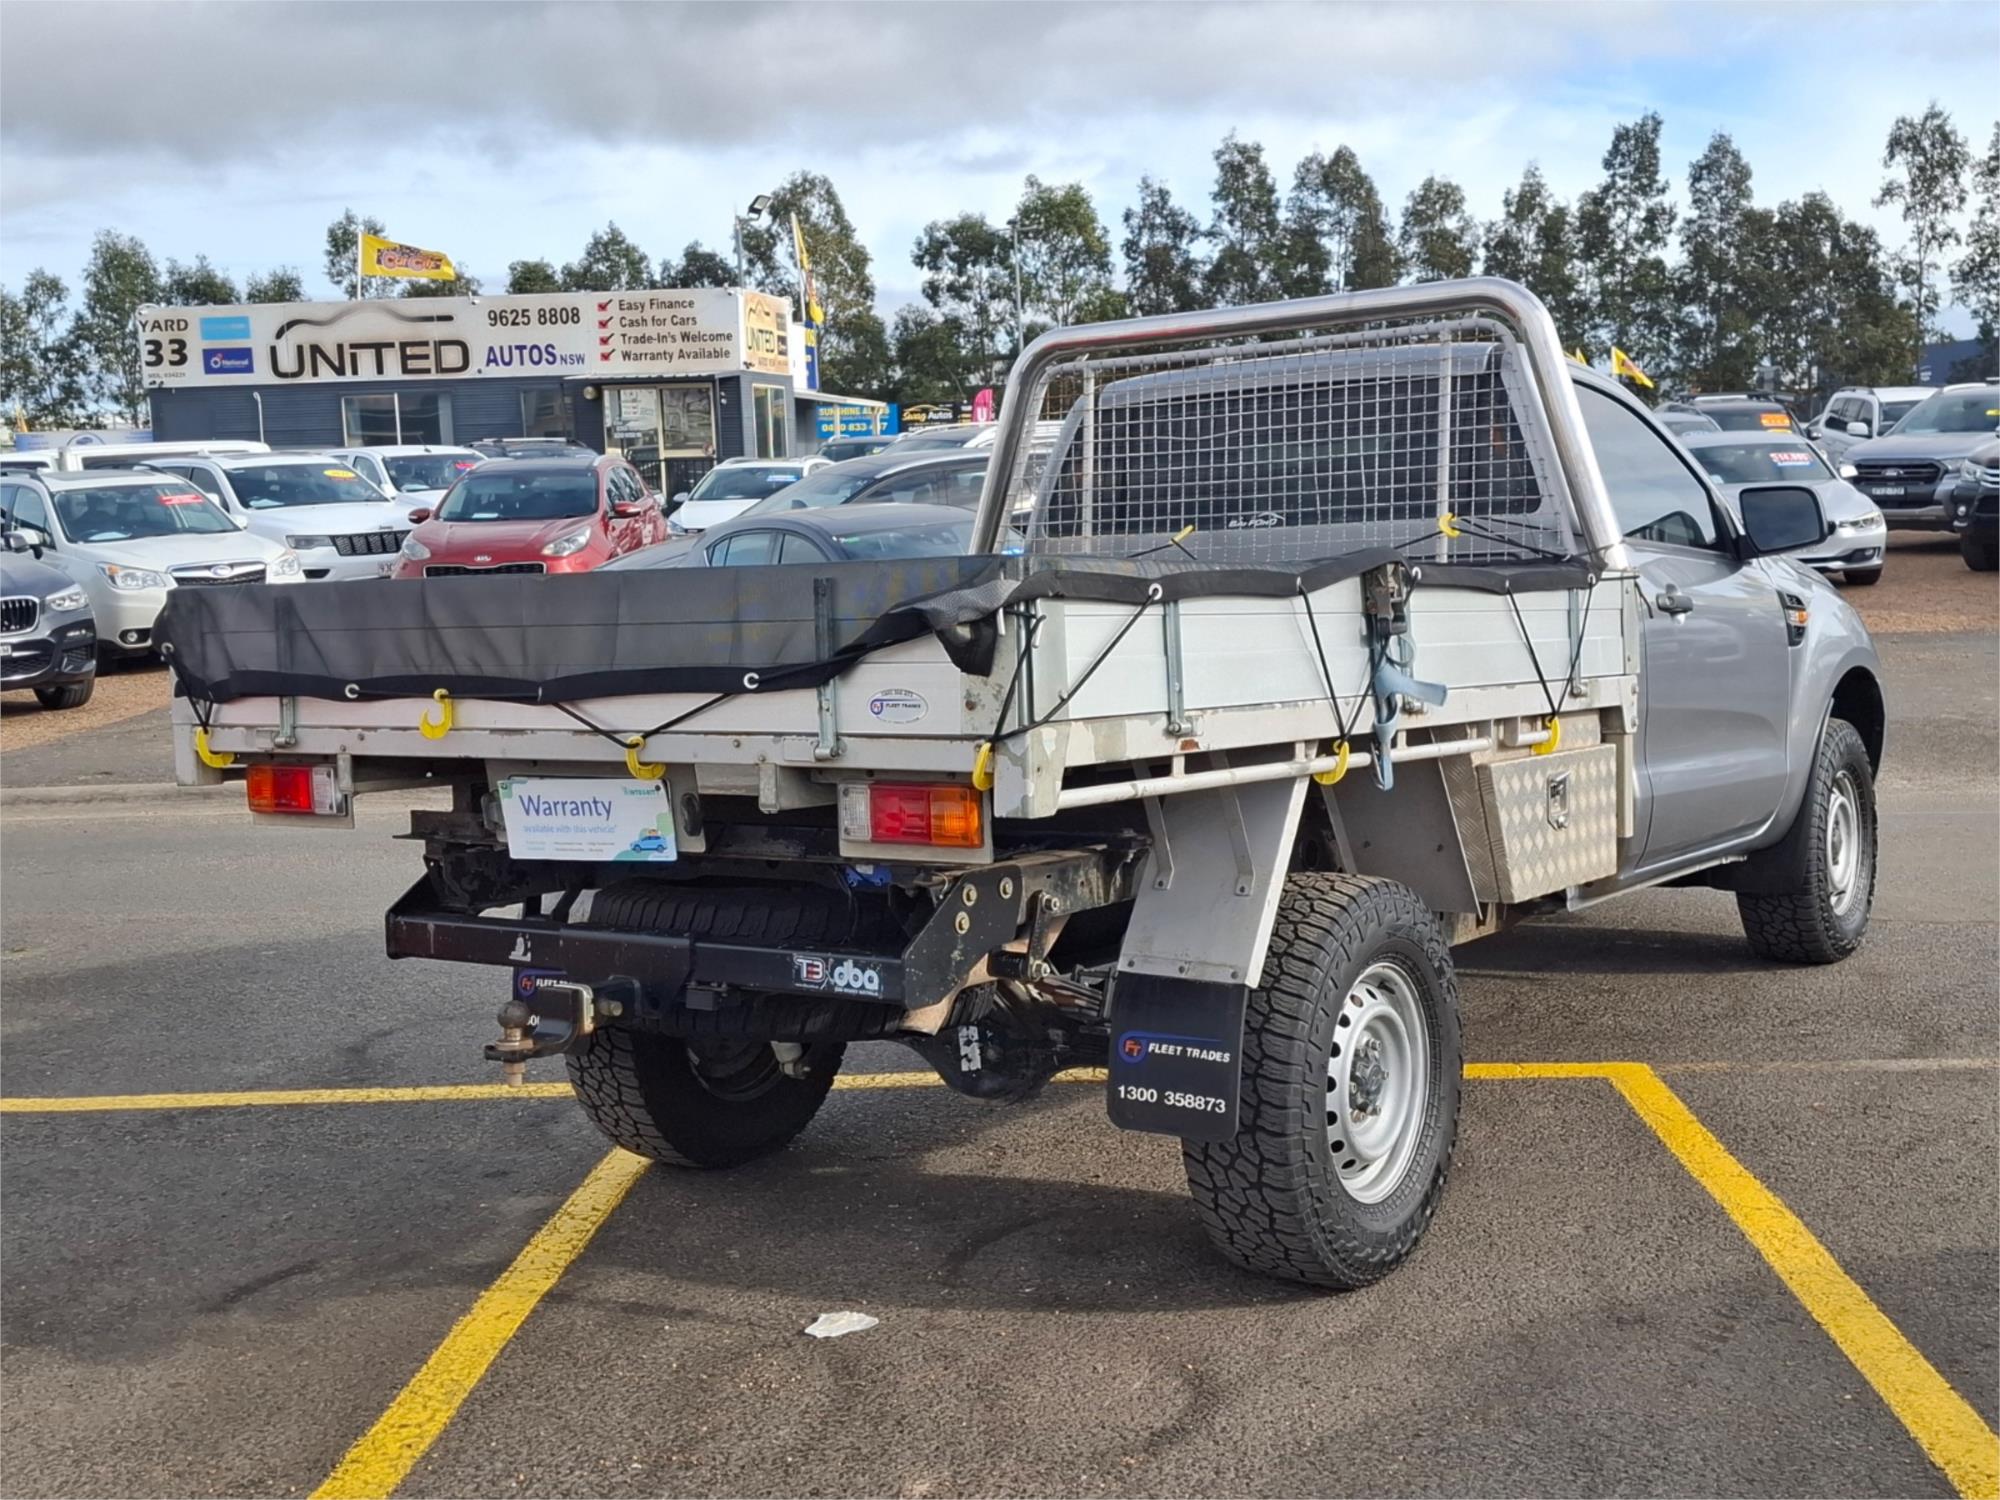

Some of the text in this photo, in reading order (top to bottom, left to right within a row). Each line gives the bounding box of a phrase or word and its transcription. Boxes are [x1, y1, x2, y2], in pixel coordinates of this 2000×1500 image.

[618, 298, 695, 312] Easy Finance
[139, 318, 189, 333] YARD
[487, 307, 581, 327] 9625 8808
[619, 314, 697, 328] Cash for Cars
[620, 331, 733, 345] Trade-In's Welcome
[144, 338, 188, 368] 33
[486, 343, 585, 367] AUTOS NSW
[621, 348, 731, 363] Warranty Available
[819, 407, 861, 416] SUNHINE
[519, 794, 612, 821] Warranty
[833, 959, 880, 990] dba
[1148, 1043, 1231, 1062] FLEET TRADES
[1118, 1084, 1226, 1114] 1300 358873
